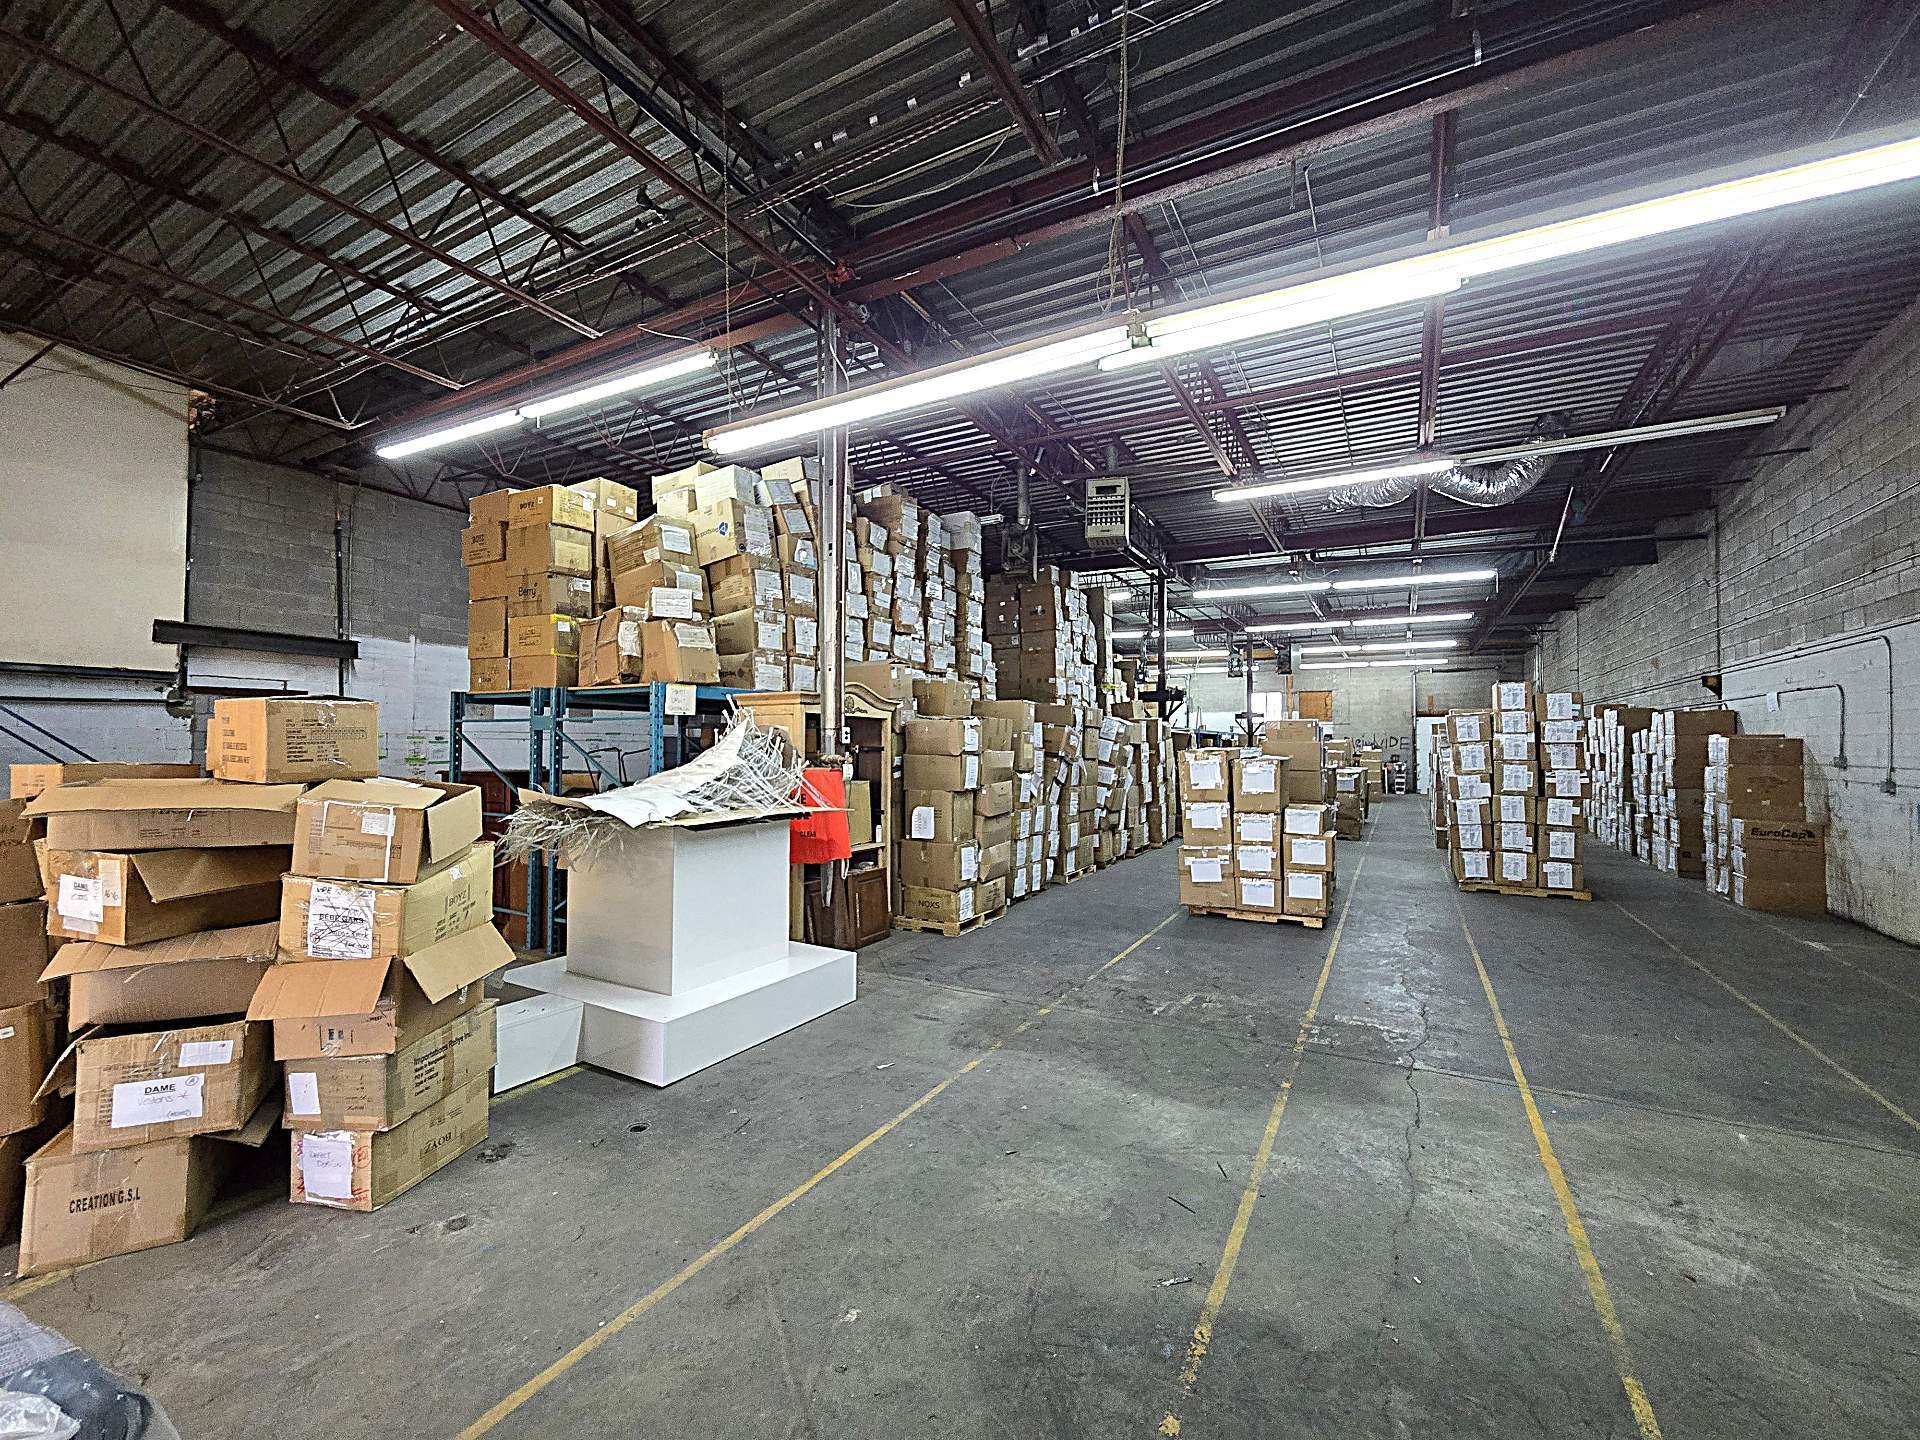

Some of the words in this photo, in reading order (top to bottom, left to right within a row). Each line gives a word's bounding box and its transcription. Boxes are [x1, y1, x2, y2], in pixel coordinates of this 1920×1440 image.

[144, 1083, 176, 1095] DAME
[69, 1192, 115, 1214] CREATION
[118, 1187, 141, 1204] G.S.L
